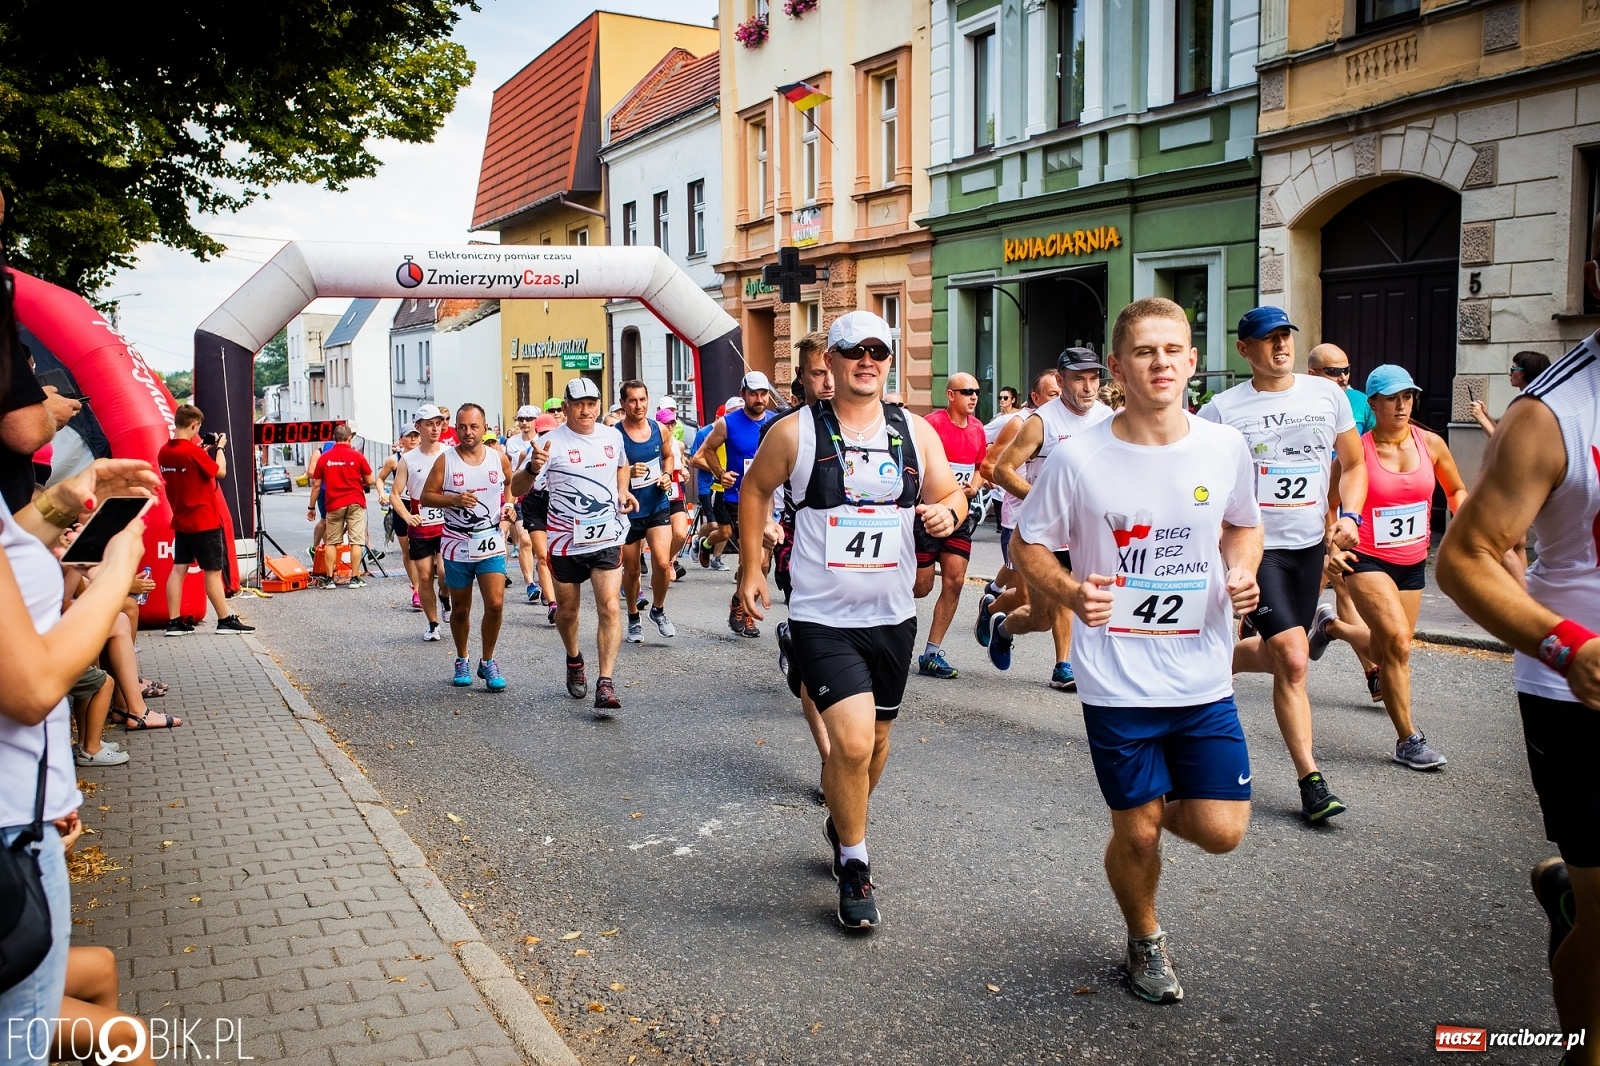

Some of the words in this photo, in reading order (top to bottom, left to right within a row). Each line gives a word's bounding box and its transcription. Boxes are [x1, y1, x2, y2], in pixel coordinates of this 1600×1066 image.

[1004, 225, 1121, 264] KWIACIARNIA
[428, 250, 501, 262] Elektroniczny
[504, 252, 541, 263] pomiar
[543, 253, 572, 261] czasu
[427, 269, 579, 289] ZmierzymyCzas.pl
[1469, 271, 1482, 294] 5
[521, 343, 537, 359] BANK
[1263, 413, 1287, 429] IV
[262, 420, 346, 445] 0:00:0
[1274, 477, 1308, 500] 32
[428, 508, 443, 520] 53
[584, 524, 606, 540] 37
[1154, 527, 1191, 541] BIEG
[1389, 516, 1415, 538] 31
[477, 537, 496, 553] 46
[845, 531, 884, 558] 41
[1154, 545, 1184, 559] BEZ
[1154, 561, 1209, 577] GRANIC
[1132, 580, 1151, 589] BIEG
[1152, 581, 1205, 589] KRZANOWICKI
[1132, 594, 1184, 625] 42
